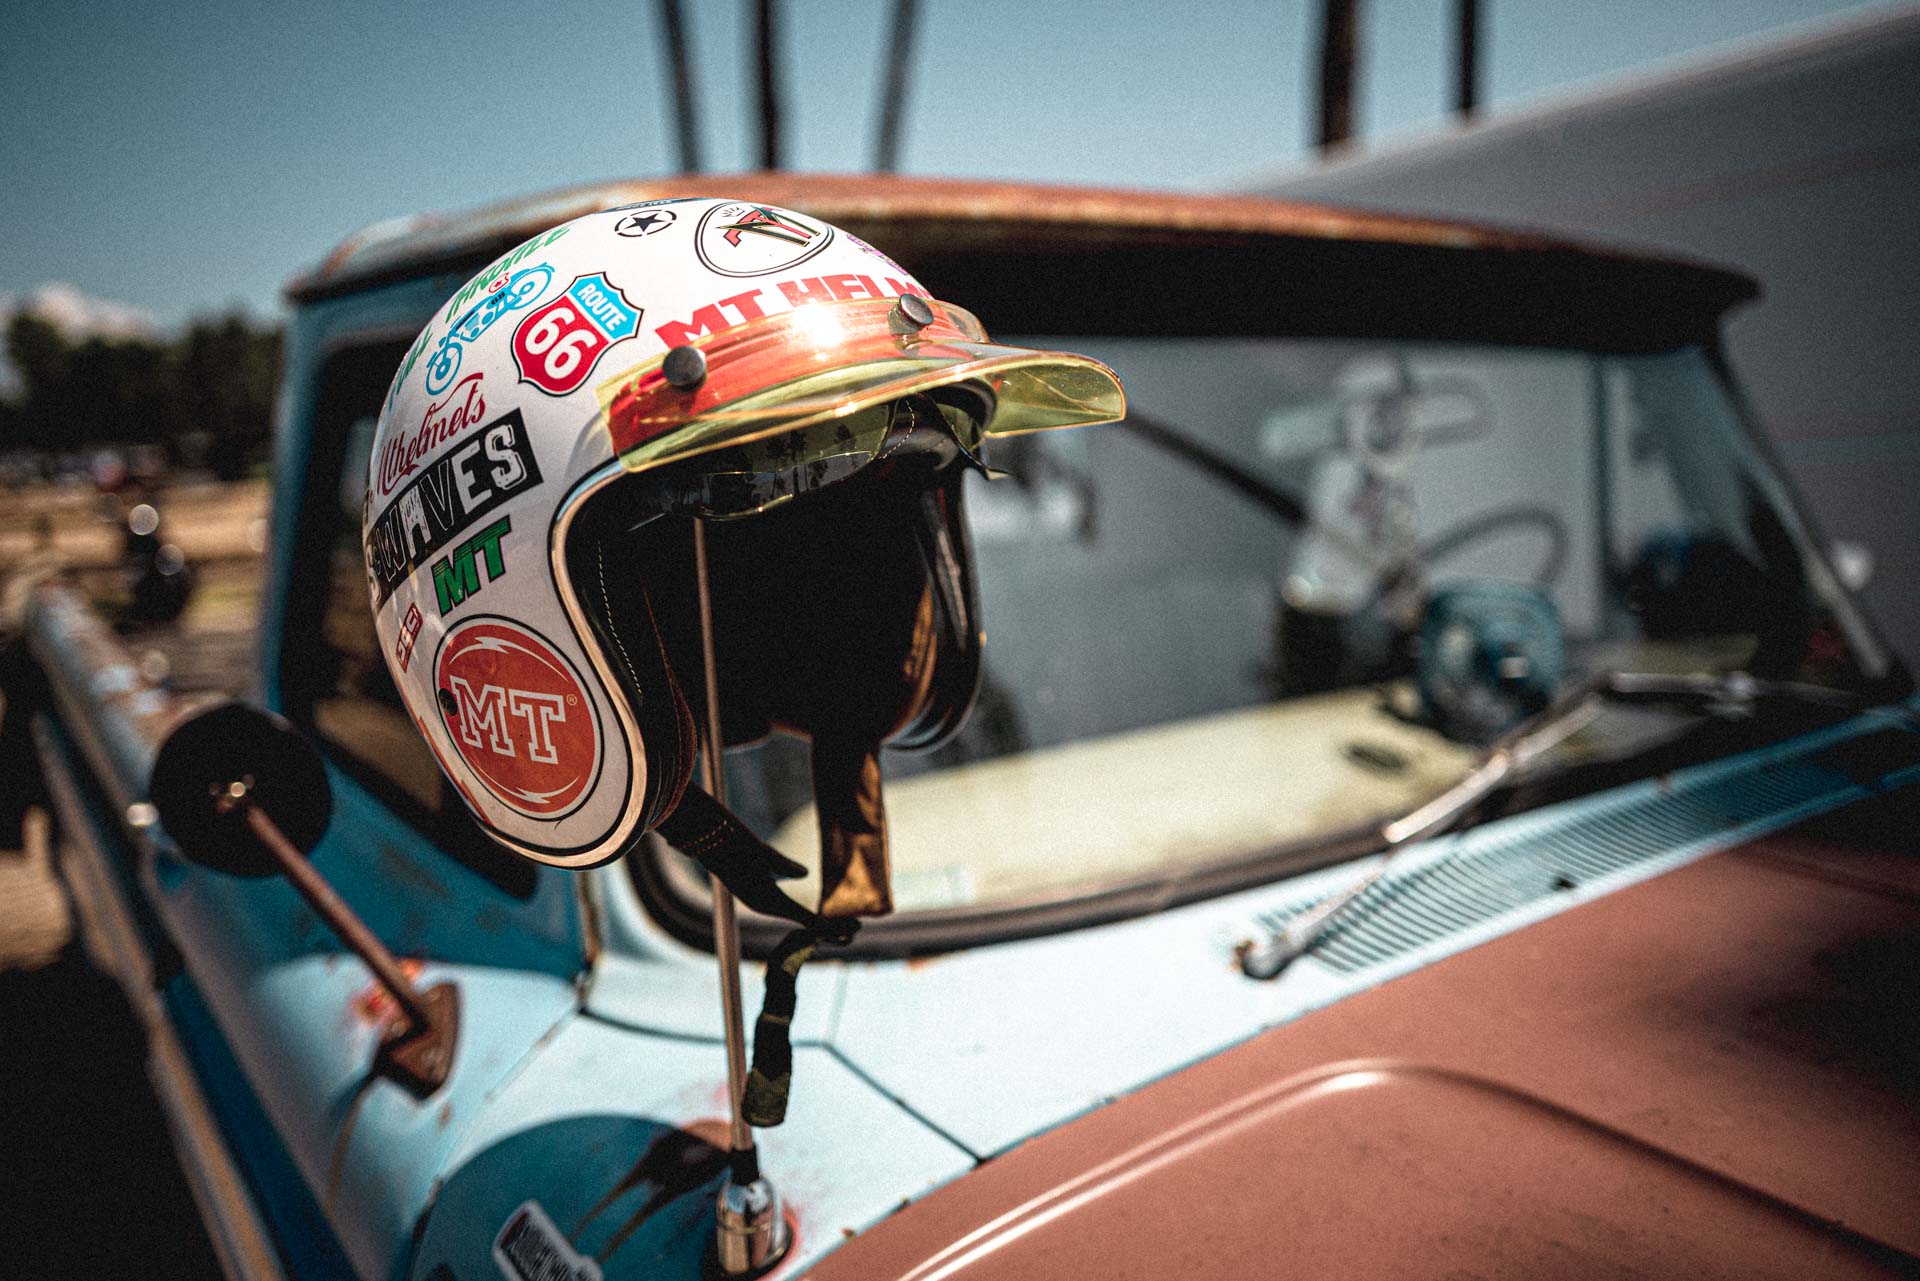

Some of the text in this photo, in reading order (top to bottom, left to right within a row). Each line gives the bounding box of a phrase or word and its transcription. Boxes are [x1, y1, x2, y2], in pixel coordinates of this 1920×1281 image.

[525, 307, 598, 380] 66
[577, 283, 628, 332] ROUTE
[655, 288, 768, 350] MT
[431, 514, 513, 618] MT
[450, 674, 567, 765] MT
